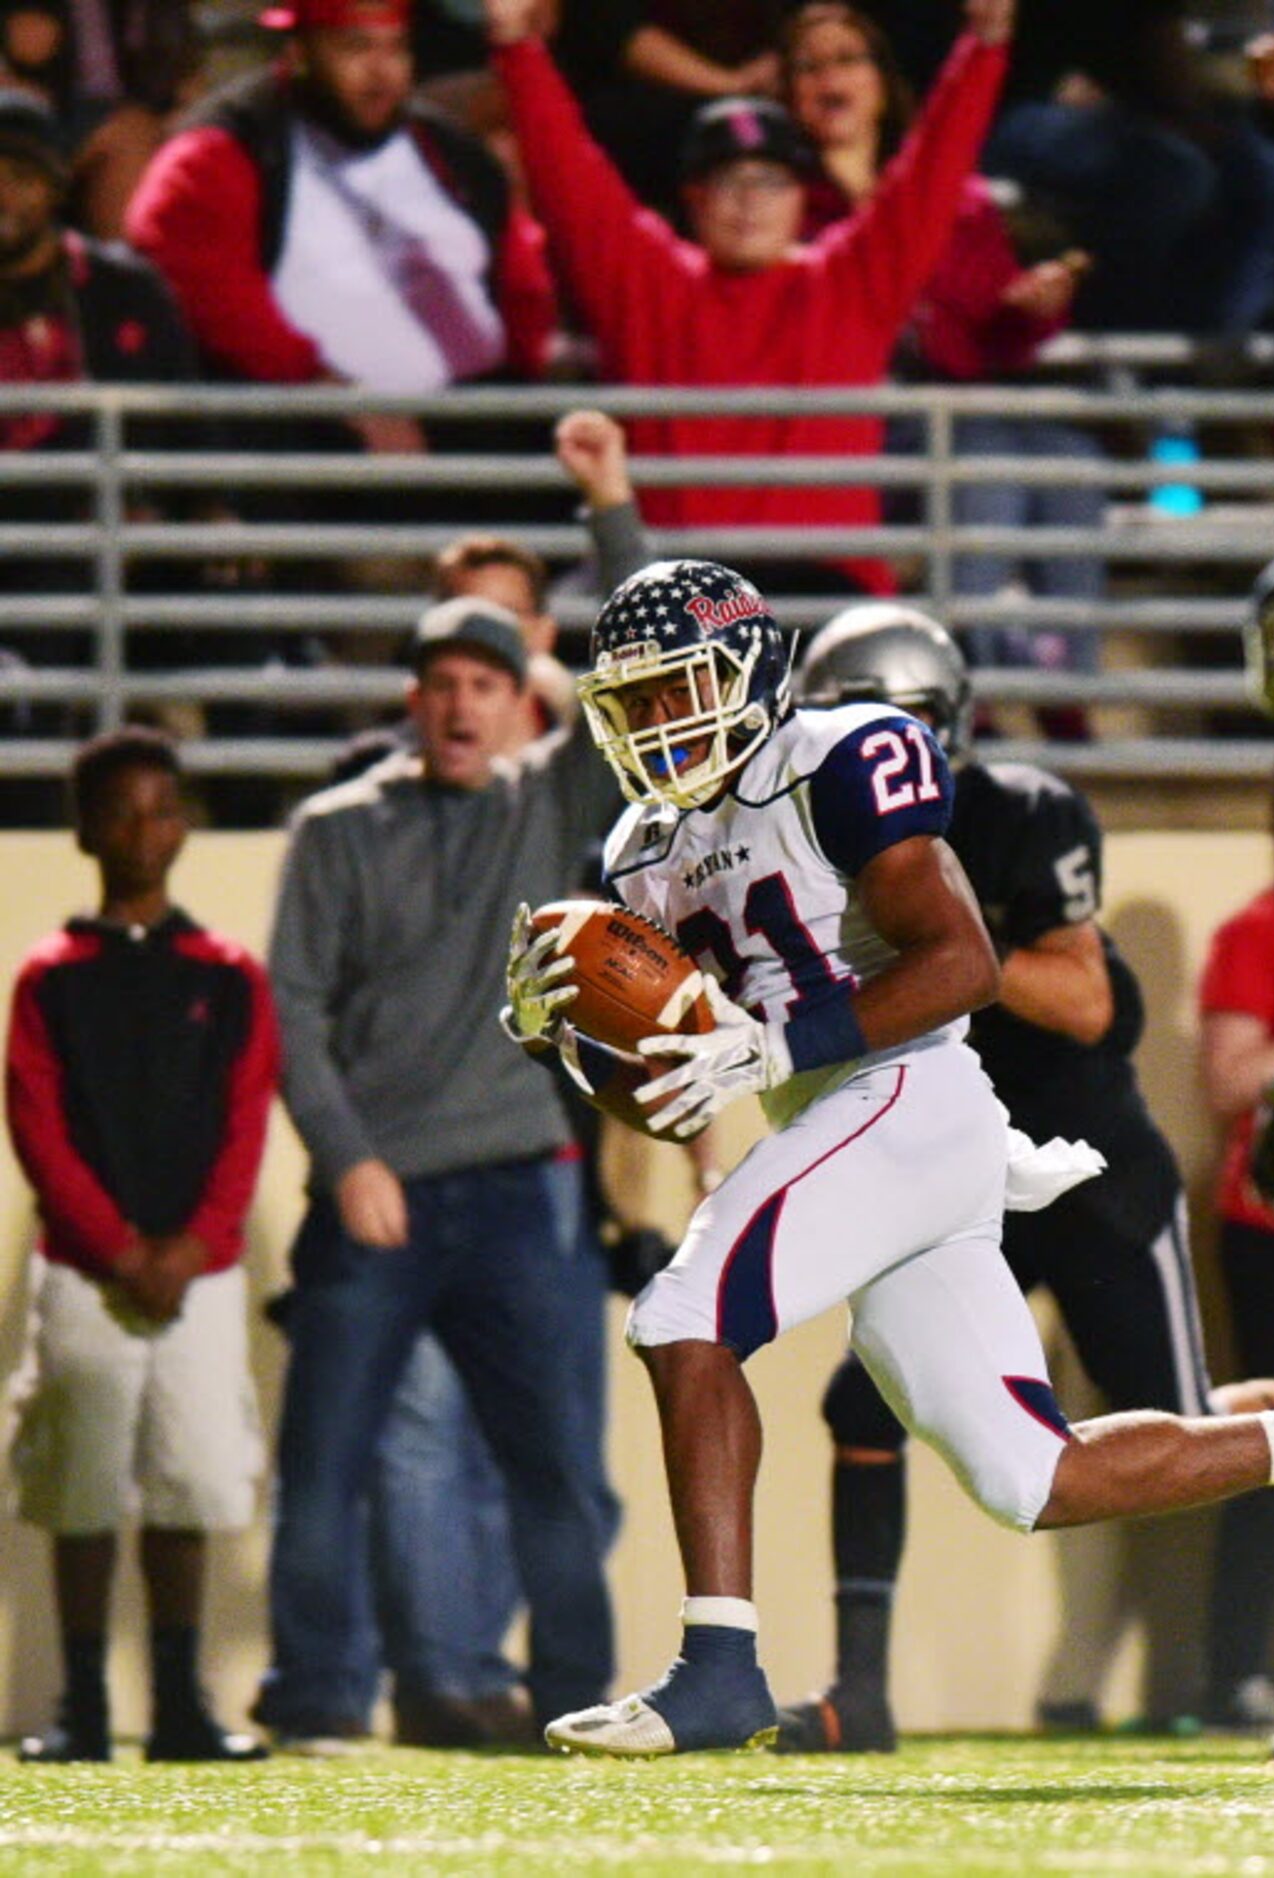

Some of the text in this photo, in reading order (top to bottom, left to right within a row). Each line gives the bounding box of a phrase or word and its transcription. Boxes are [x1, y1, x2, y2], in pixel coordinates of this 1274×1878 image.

[859, 722, 942, 817] 21
[1053, 846, 1096, 921] 5
[606, 919, 669, 969] Wilson
[676, 870, 861, 1025] 21
